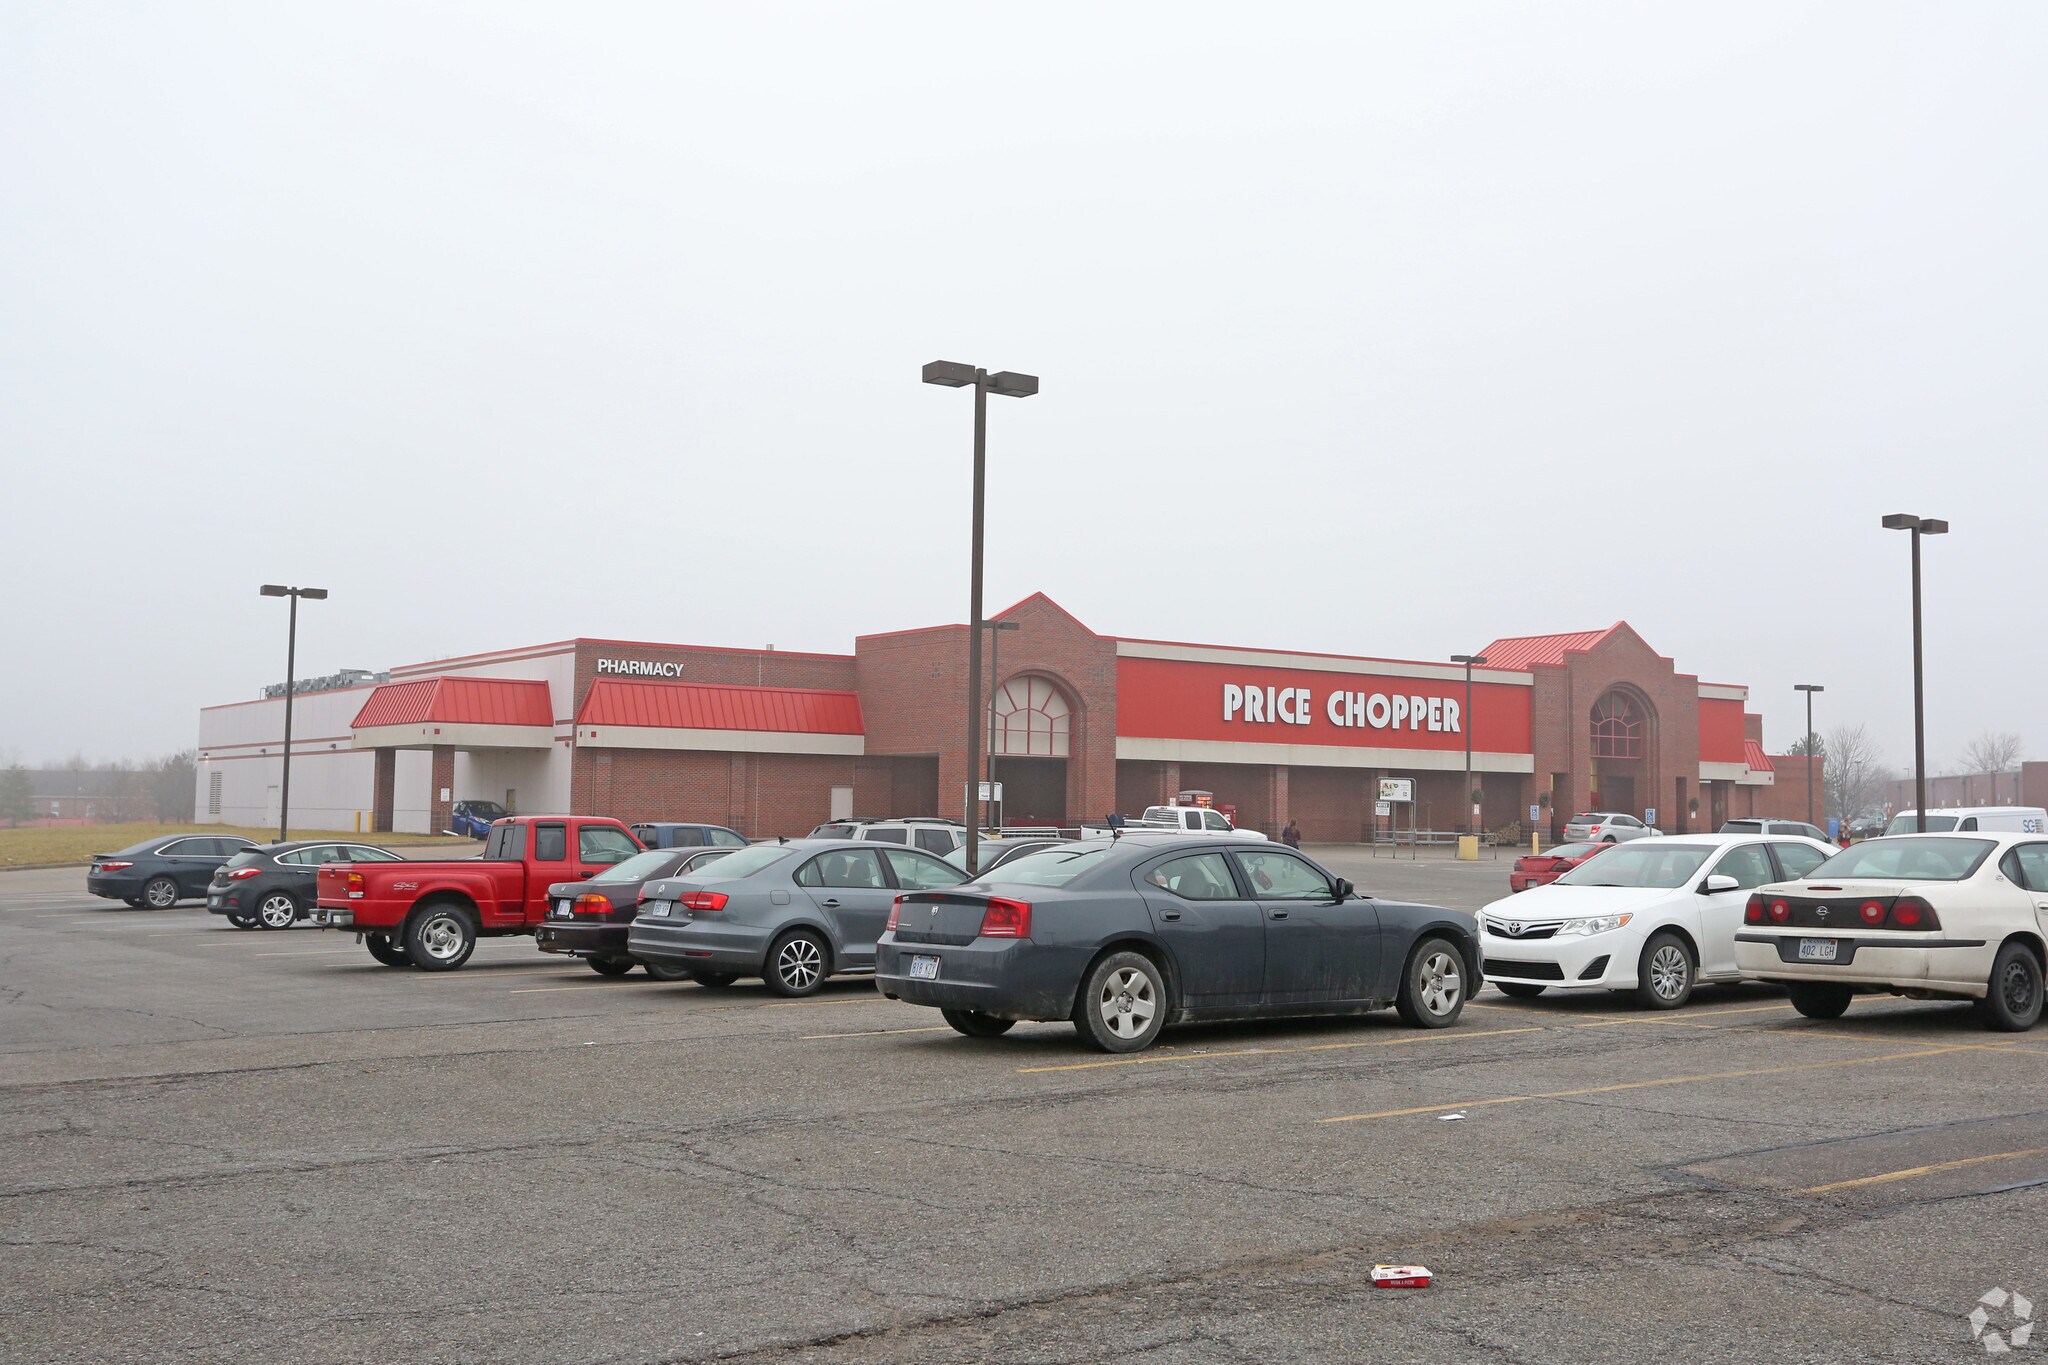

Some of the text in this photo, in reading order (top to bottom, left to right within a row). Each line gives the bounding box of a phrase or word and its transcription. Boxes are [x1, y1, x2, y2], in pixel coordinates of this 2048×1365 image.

[597, 658, 684, 677] PHARMACY
[1223, 683, 1461, 732] PRICE CHOPPER
[1801, 945, 1835, 957] 402 LGH
